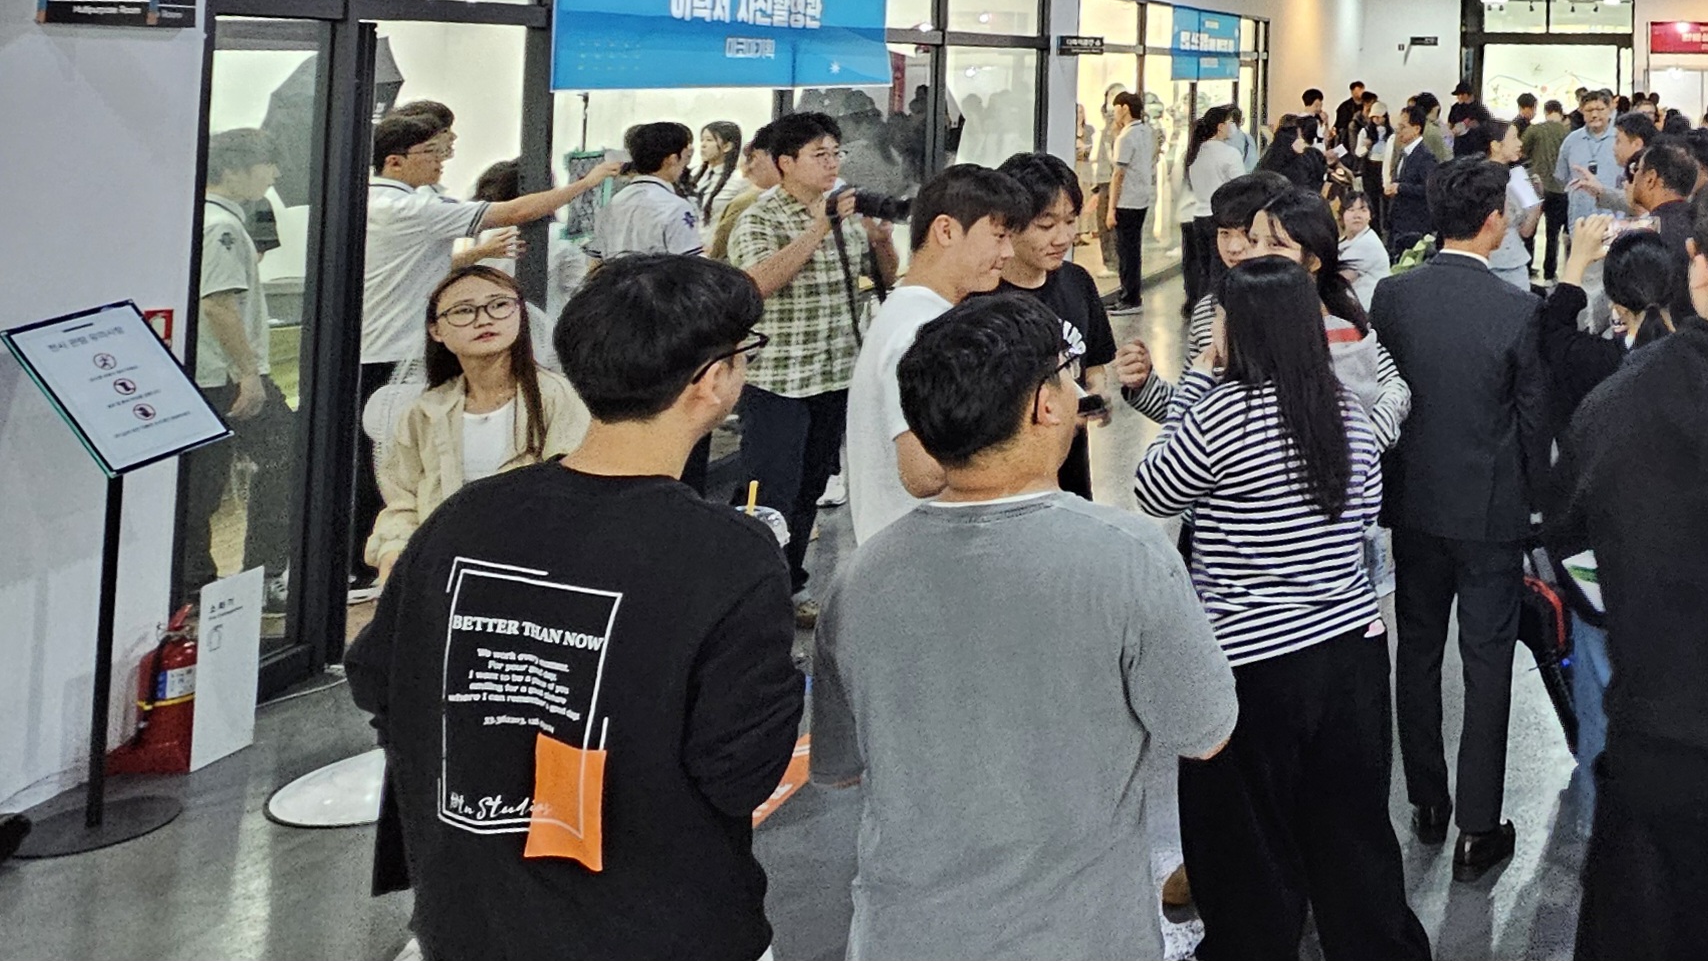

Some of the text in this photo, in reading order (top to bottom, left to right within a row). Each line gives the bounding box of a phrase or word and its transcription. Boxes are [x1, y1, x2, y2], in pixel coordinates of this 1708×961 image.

[452, 614, 605, 651] BETTER THAN NOW
